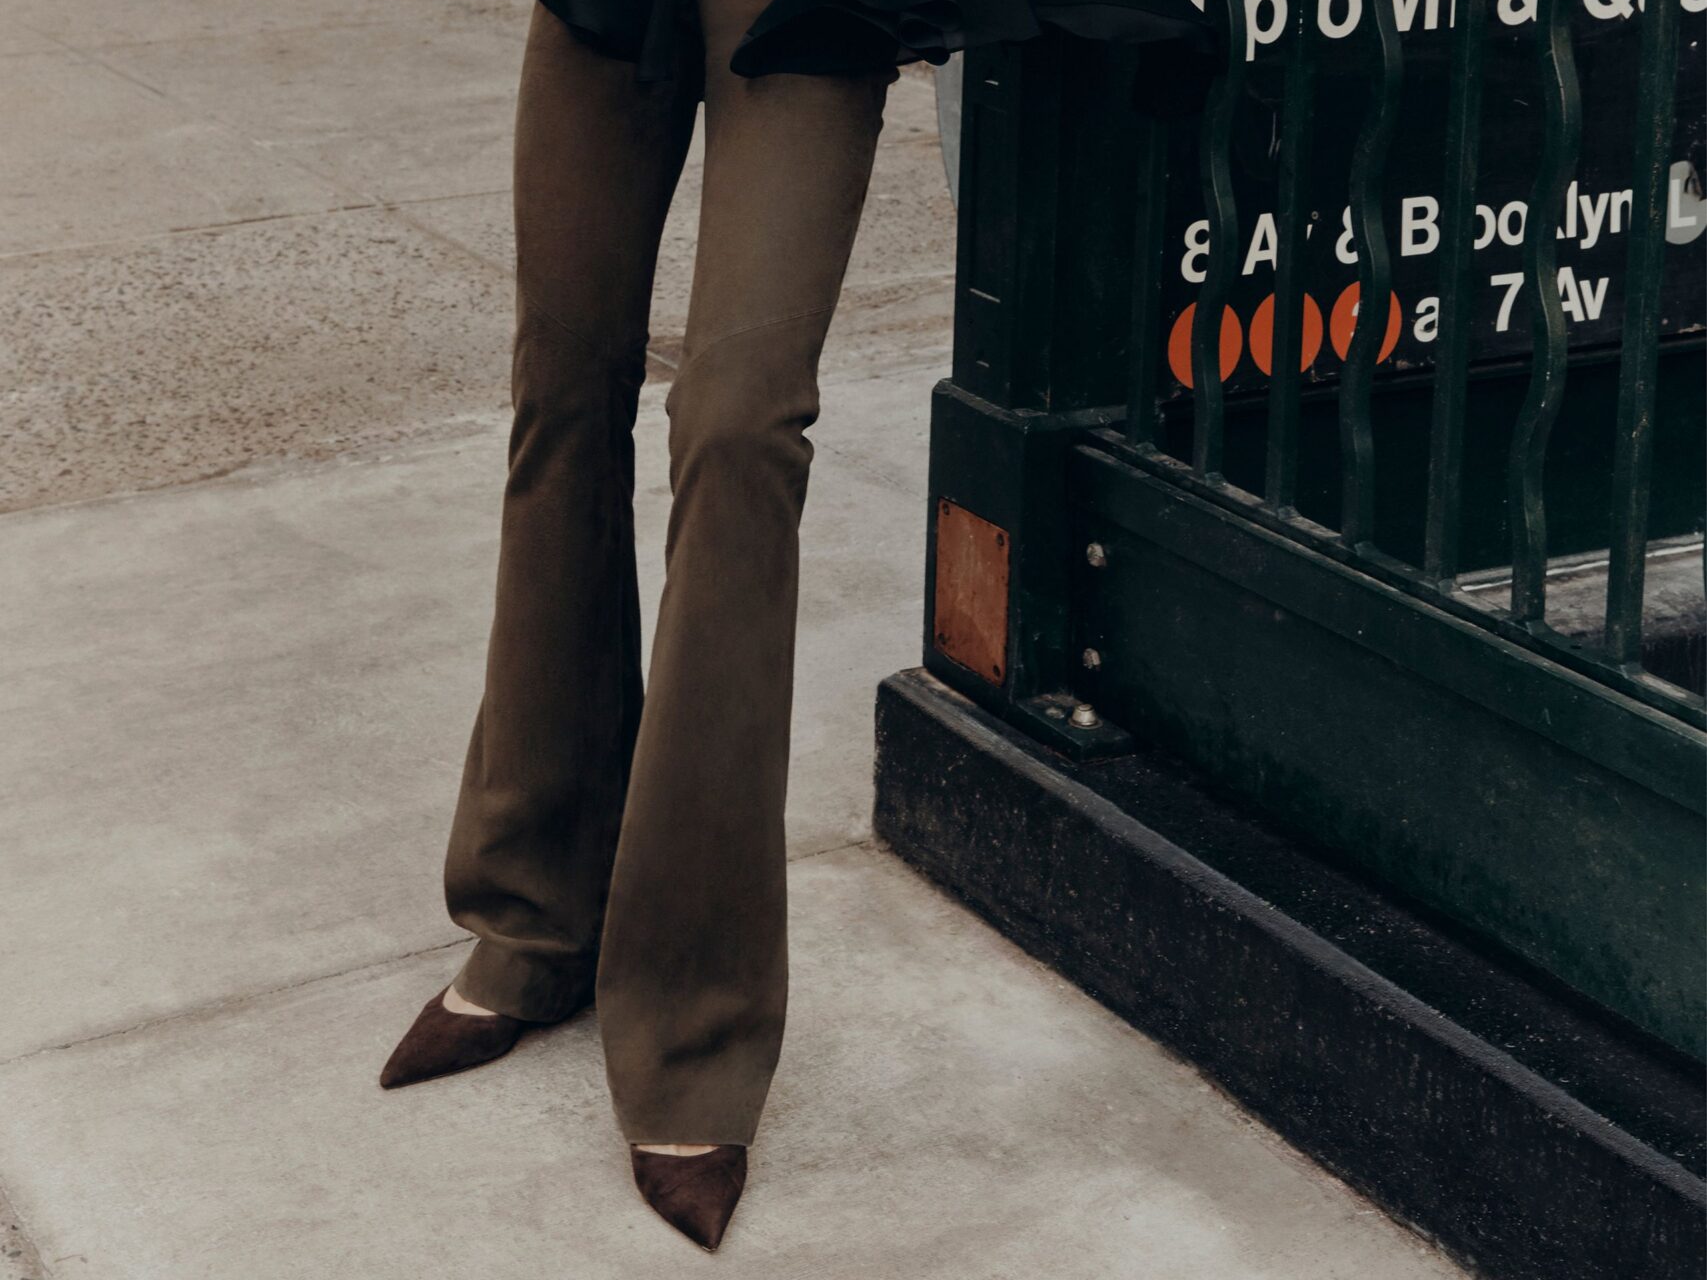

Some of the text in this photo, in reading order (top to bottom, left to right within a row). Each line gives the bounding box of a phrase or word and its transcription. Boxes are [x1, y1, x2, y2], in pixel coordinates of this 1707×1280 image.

[1241, 212, 1313, 276] A
[1401, 179, 1634, 257] Boolyn
[1490, 271, 1525, 332] 7
[1556, 266, 1610, 322] Av
